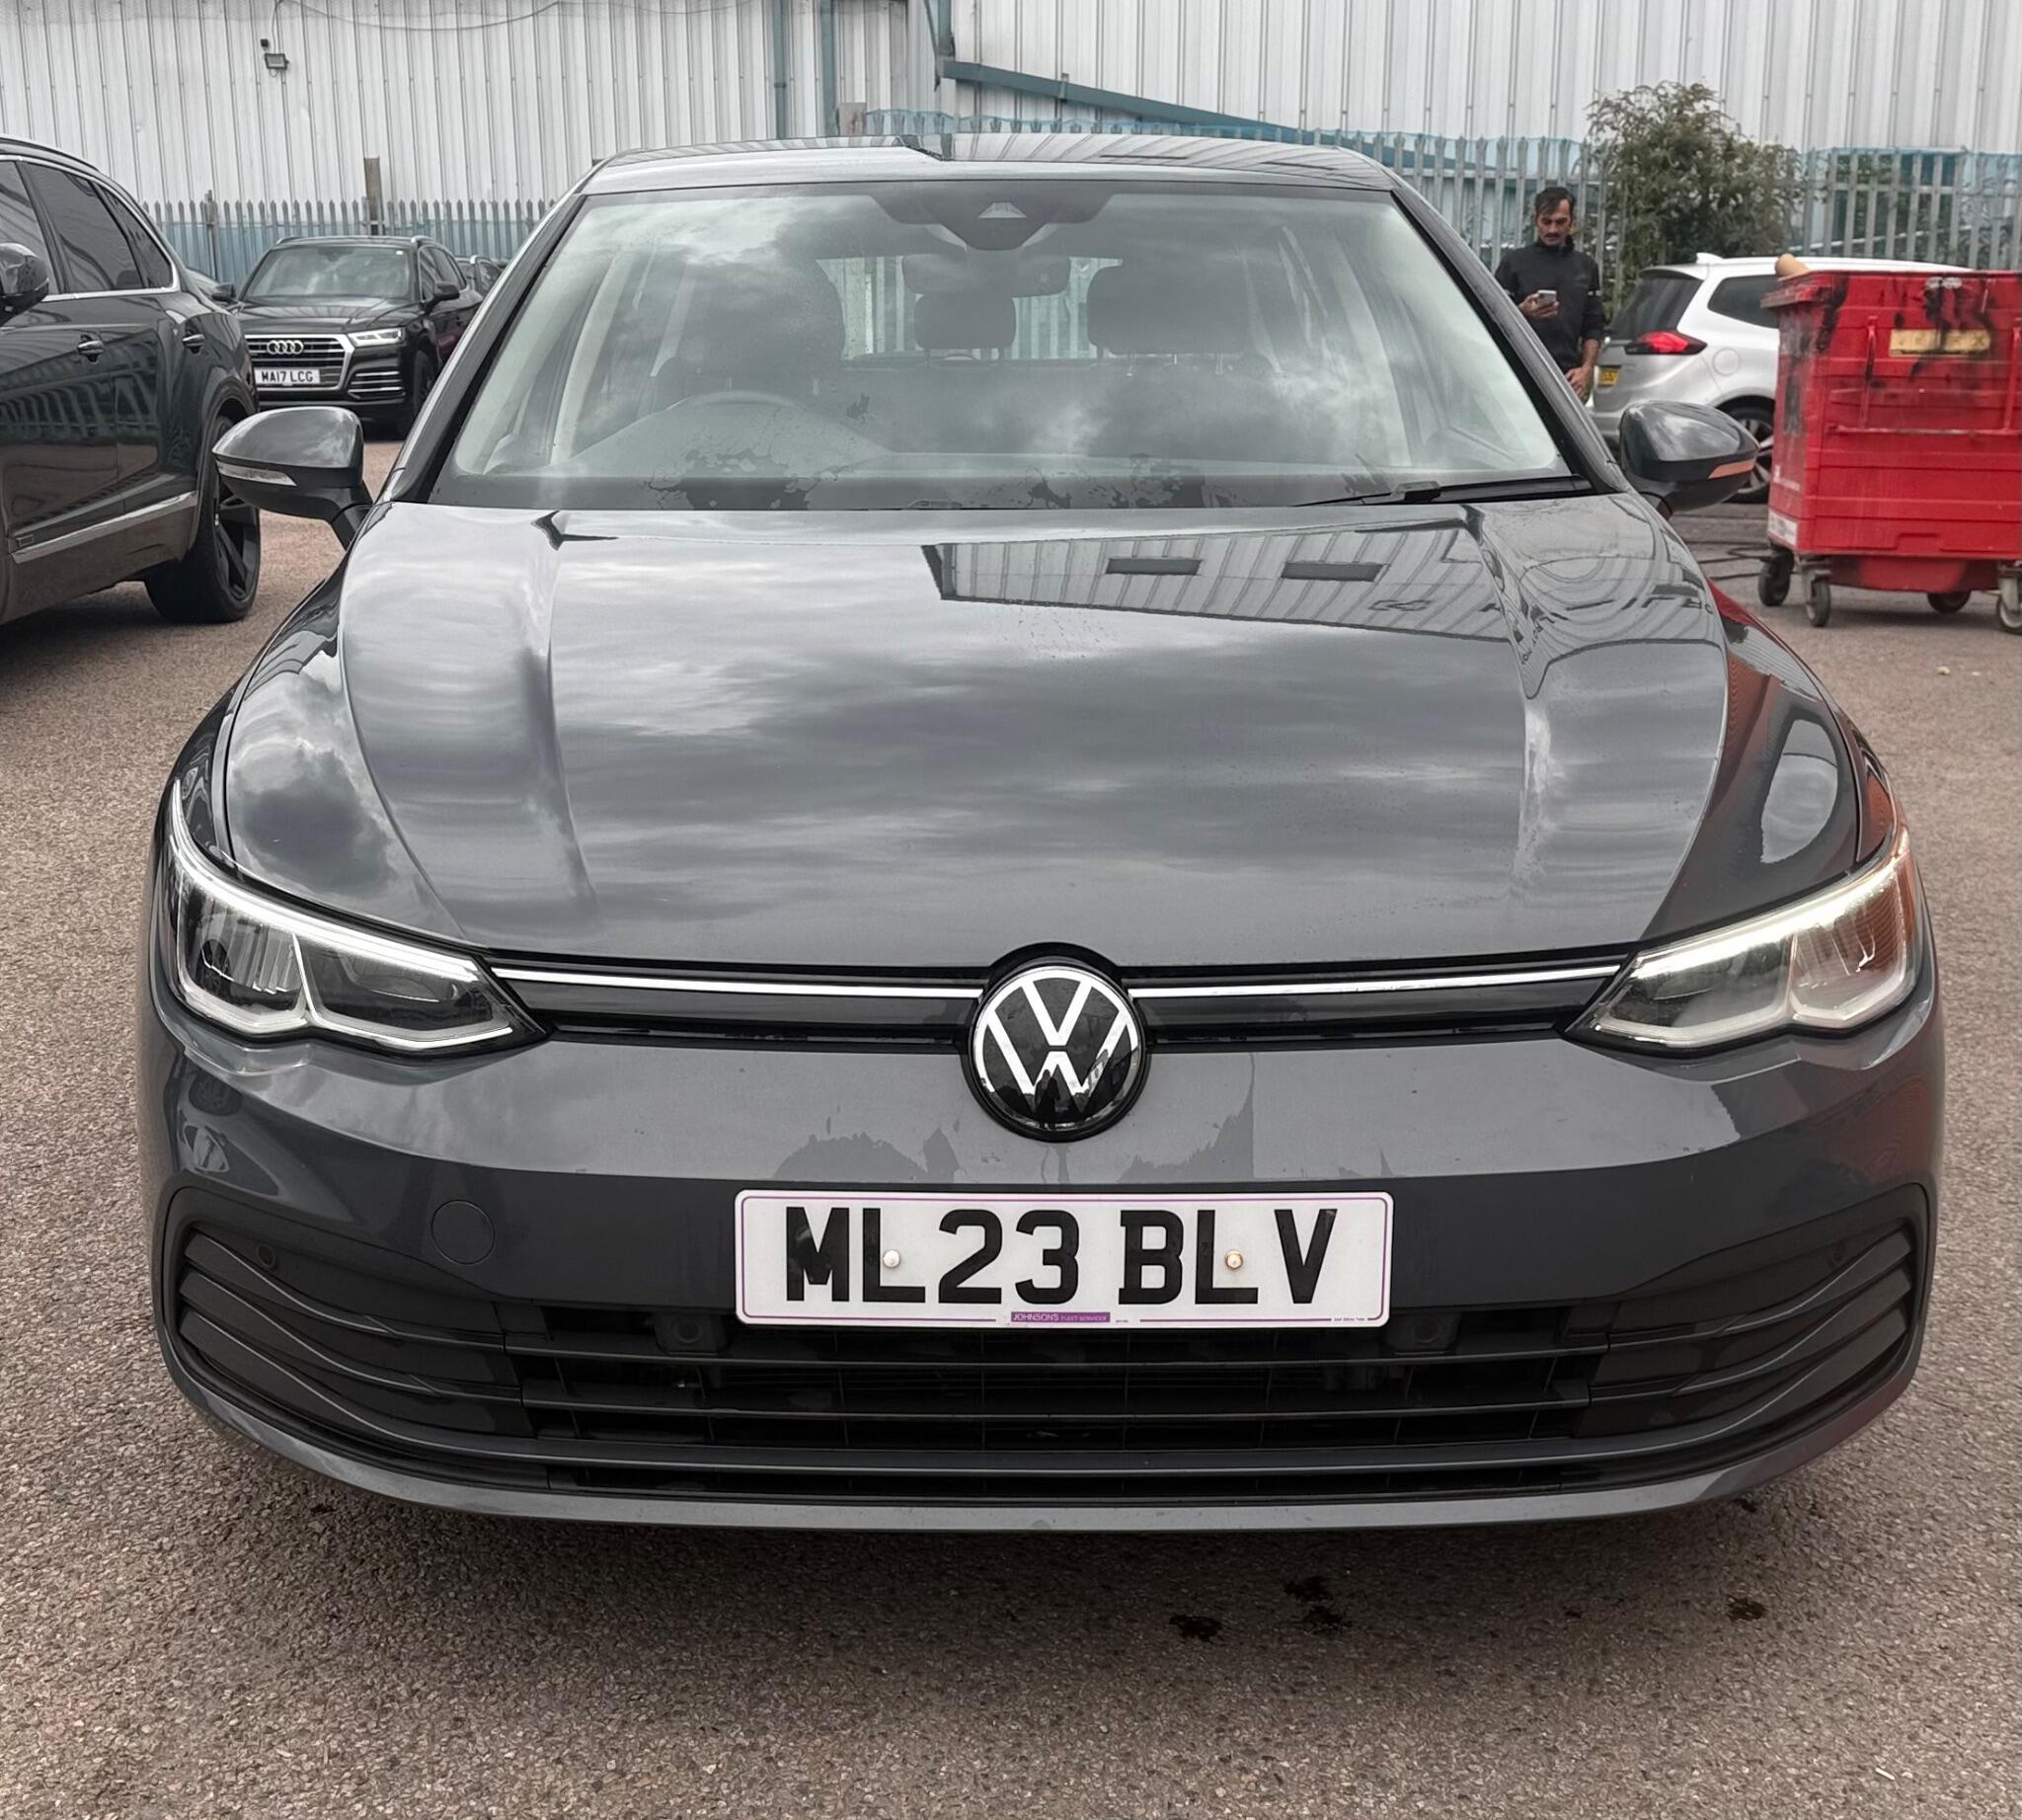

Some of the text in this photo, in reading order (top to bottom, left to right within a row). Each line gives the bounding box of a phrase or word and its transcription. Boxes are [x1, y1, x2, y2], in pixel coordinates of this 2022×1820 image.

[262, 370, 313, 382] MA17 LCG
[786, 1207, 1338, 1306] ML23 BLV
